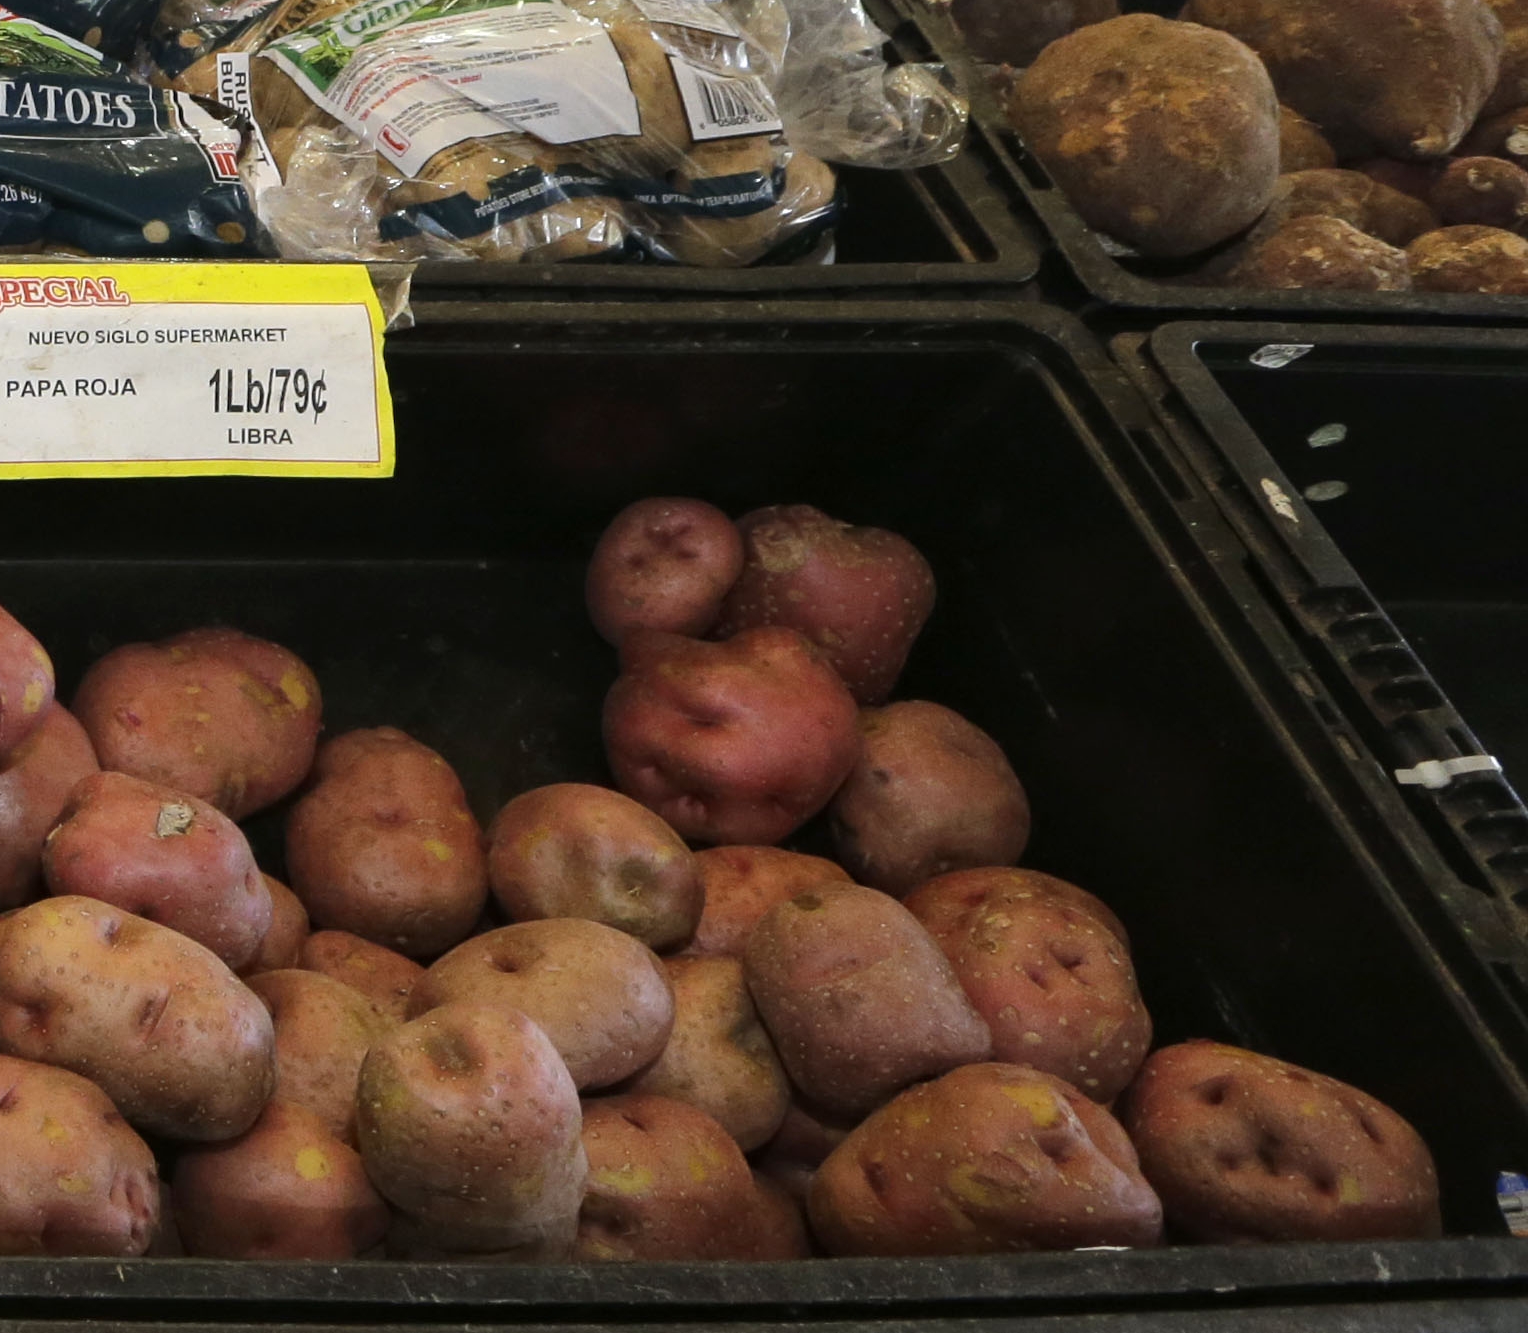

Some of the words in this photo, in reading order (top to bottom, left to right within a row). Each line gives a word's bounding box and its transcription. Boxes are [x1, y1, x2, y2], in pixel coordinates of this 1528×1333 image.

[28, 330, 90, 346] NUEVO
[94, 329, 150, 345] SIGLO
[154, 328, 289, 344] SUPERMARKET
[6, 379, 68, 398] PAPA
[75, 377, 137, 397] ROJA
[208, 368, 328, 424] 1Lb/79¢
[228, 427, 293, 445] LIBRA
